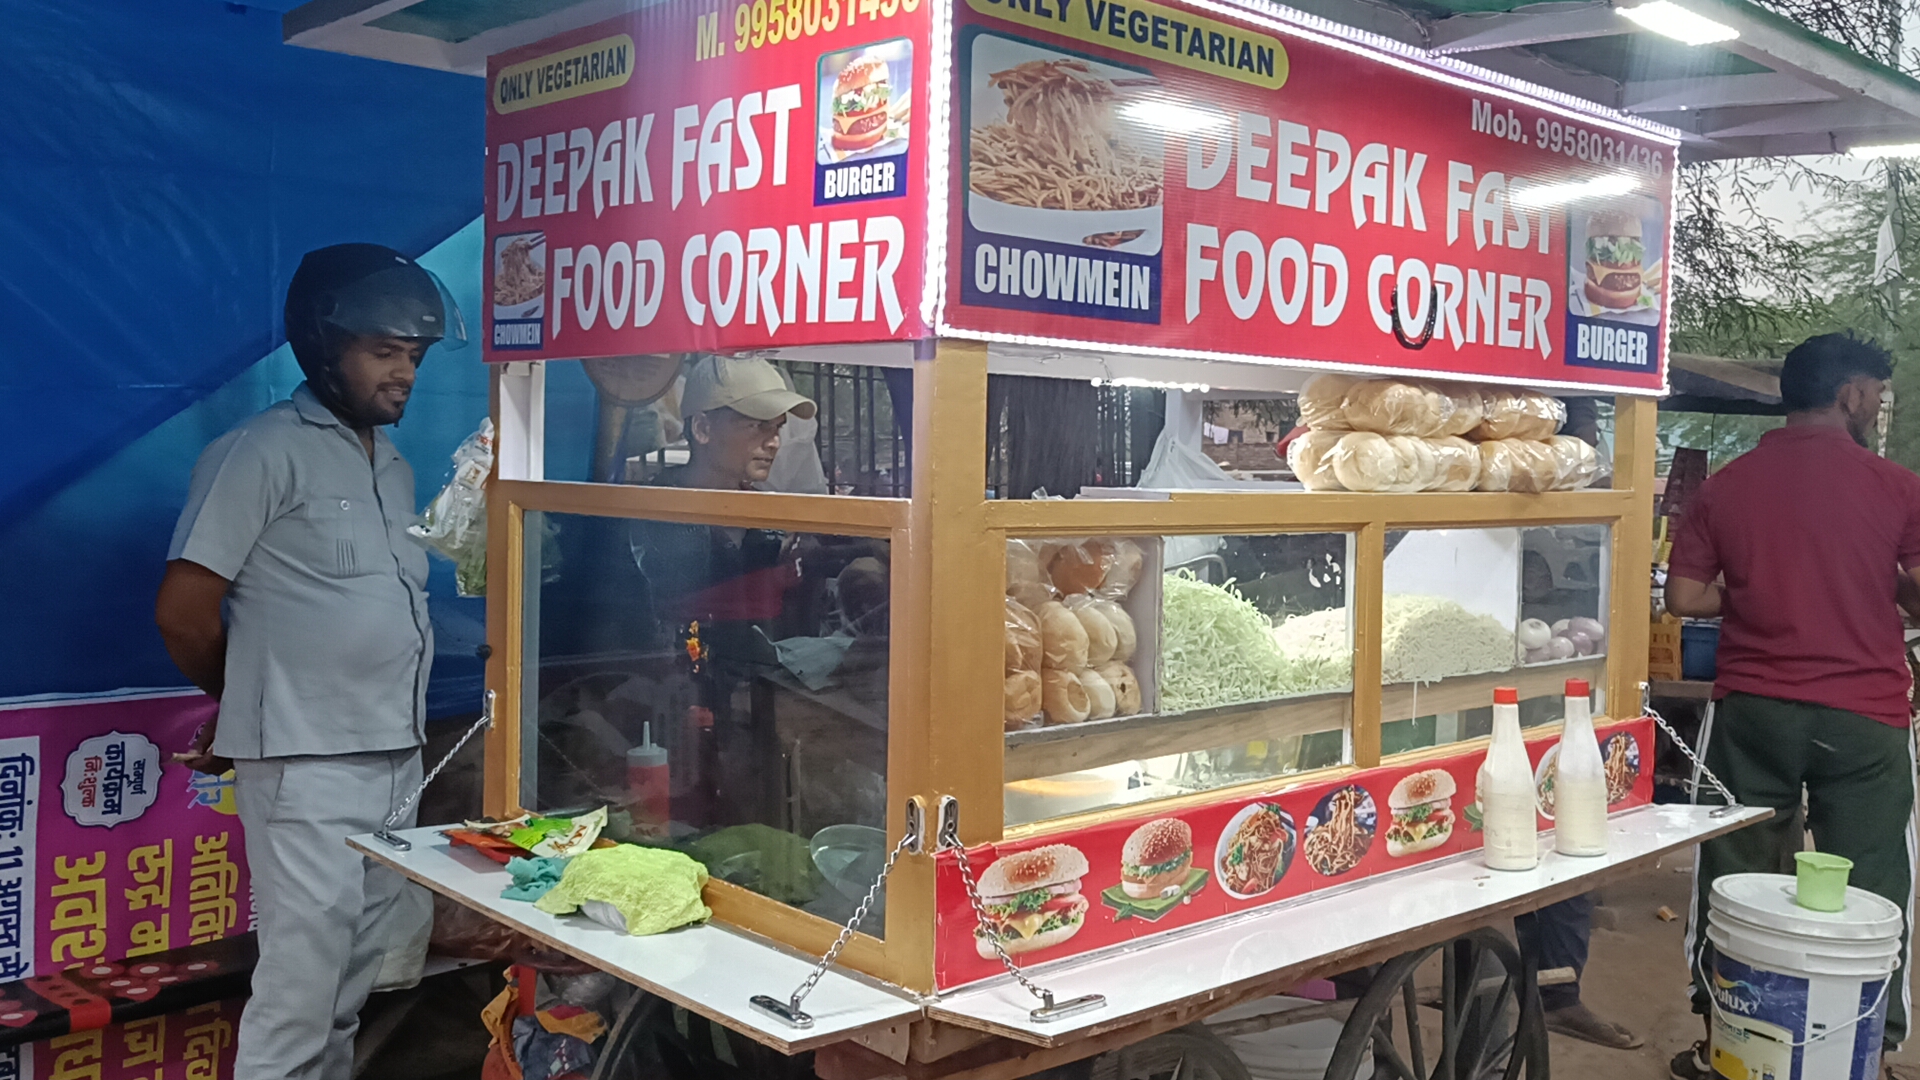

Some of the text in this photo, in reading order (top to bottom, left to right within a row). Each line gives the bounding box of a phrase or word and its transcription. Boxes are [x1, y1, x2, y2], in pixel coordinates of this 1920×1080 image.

[696, 12, 725, 61] M.
[1087, 0, 1275, 77] VEGETARIAN
[500, 45, 627, 106] ONLY VEGETARIAN
[497, 84, 802, 222] DEEPAK FAST
[1186, 103, 1428, 232] DEEPAK
[1472, 99, 1663, 178] Mob. 9958031436
[823, 161, 895, 200] BURGER
[552, 215, 905, 340] FOOD CORNER
[974, 243, 1150, 311] CHOWMEIN
[1185, 223, 1552, 360] FOOD CORNER
[493, 322, 542, 346] CHOWMEIN
[1577, 323, 1648, 365] BURGER
[101, 741, 130, 815] कार्यक्रम
[1712, 983, 1751, 1014] Dulux
